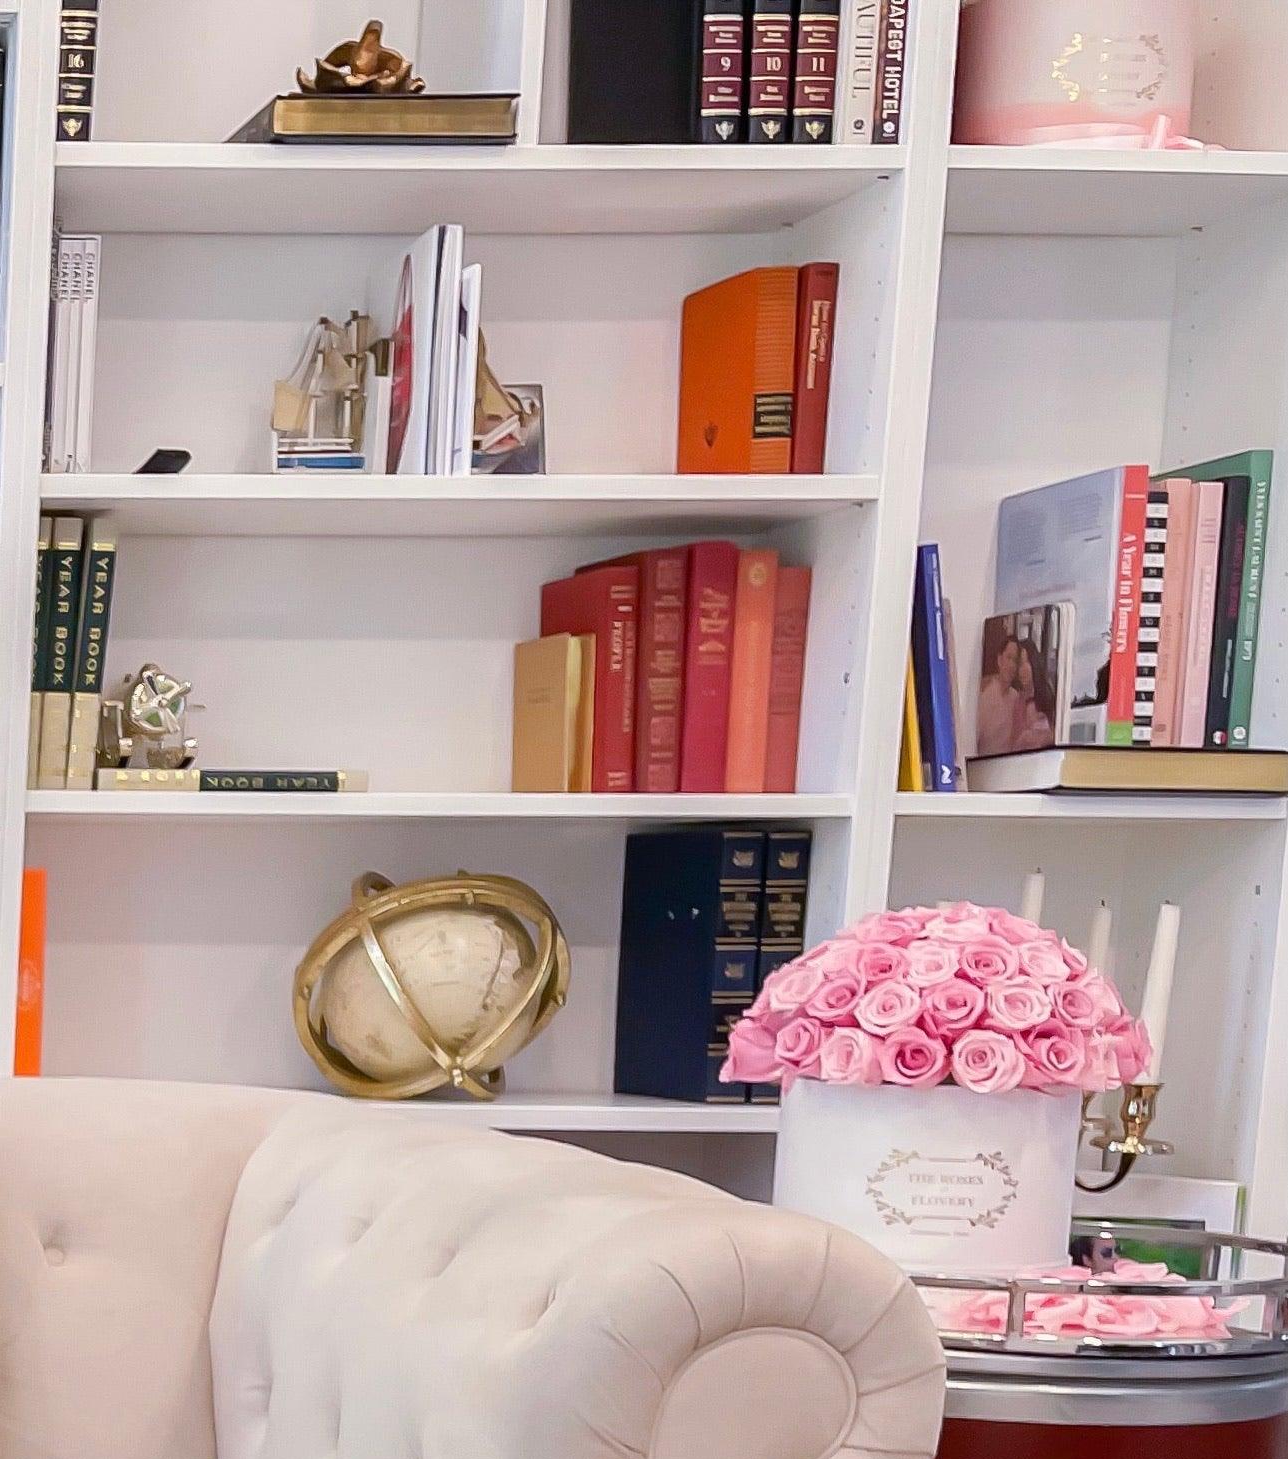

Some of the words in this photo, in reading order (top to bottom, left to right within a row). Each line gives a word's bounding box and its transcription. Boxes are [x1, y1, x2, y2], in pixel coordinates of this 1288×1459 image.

[720, 57, 731, 71] 9
[766, 57, 782, 71] 10
[811, 57, 825, 71] 11
[882, 66, 902, 119] HOTEL
[57, 555, 74, 614] YEAR
[92, 557, 109, 615] YEAR
[52, 626, 68, 685] BOOK
[85, 627, 101, 686] BOOK
